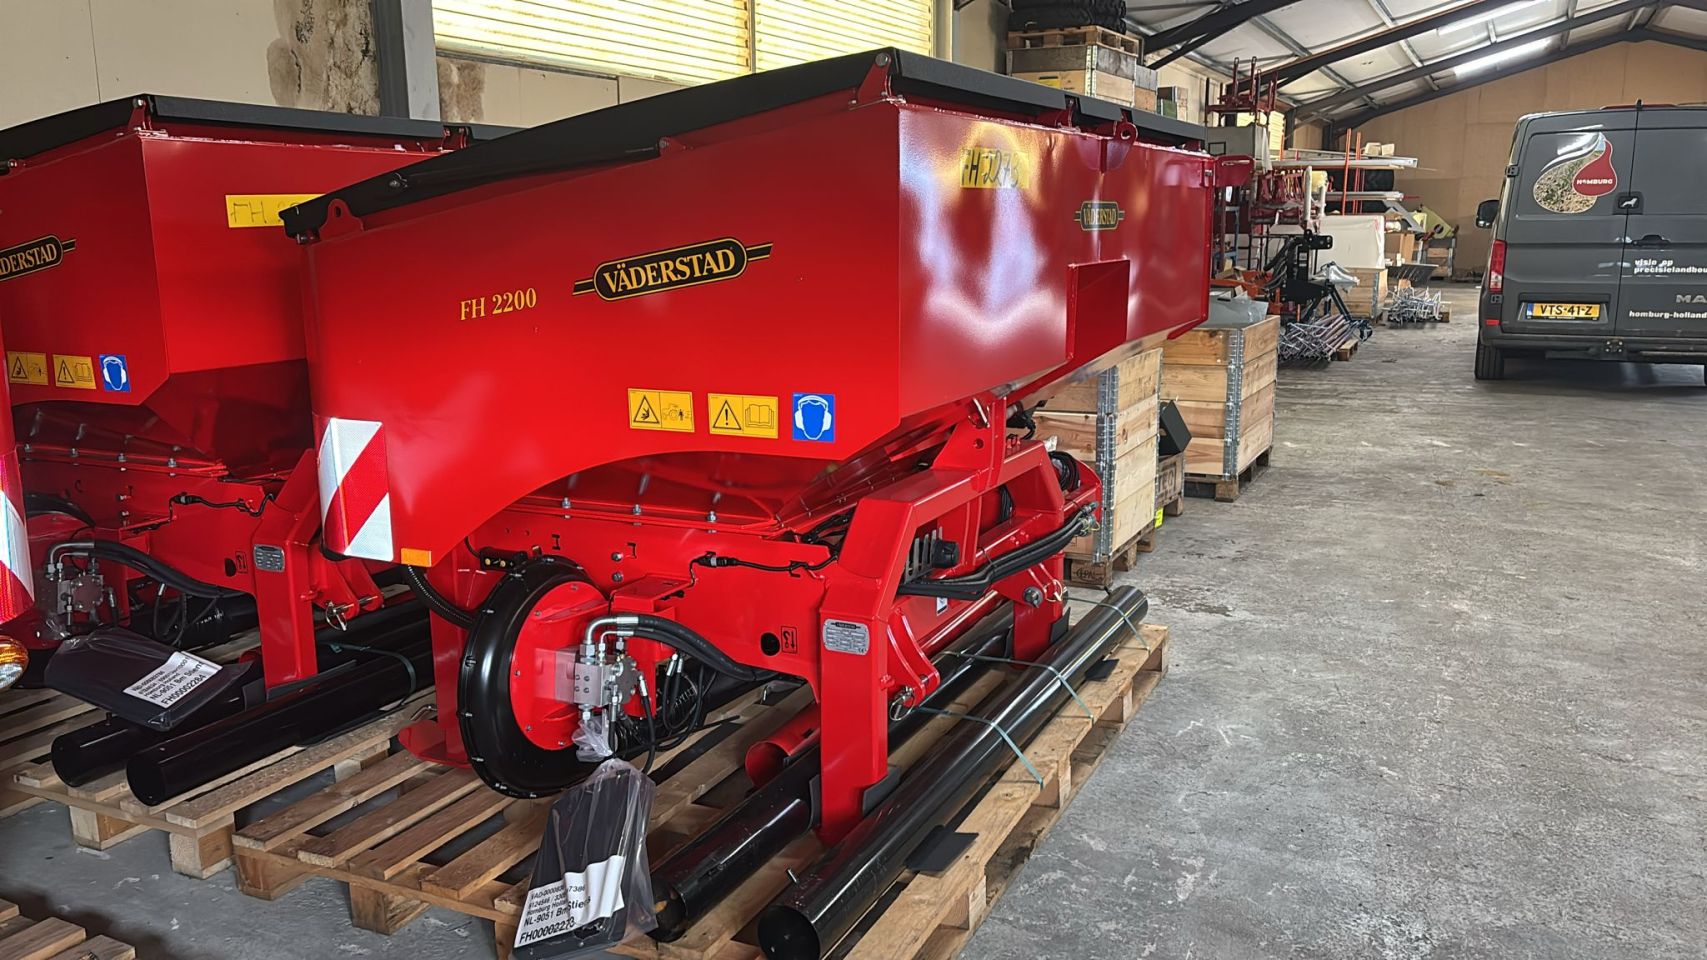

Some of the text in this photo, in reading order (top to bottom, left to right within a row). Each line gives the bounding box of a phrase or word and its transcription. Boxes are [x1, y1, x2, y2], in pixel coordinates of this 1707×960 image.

[1083, 204, 1117, 225] VÄDERSTAD
[603, 248, 735, 294] VÄDERSTAD
[1661, 259, 1674, 267] op
[460, 287, 538, 321] FH 2200
[1540, 304, 1593, 316] VTS-41-Z
[523, 911, 554, 927] NL-9051
